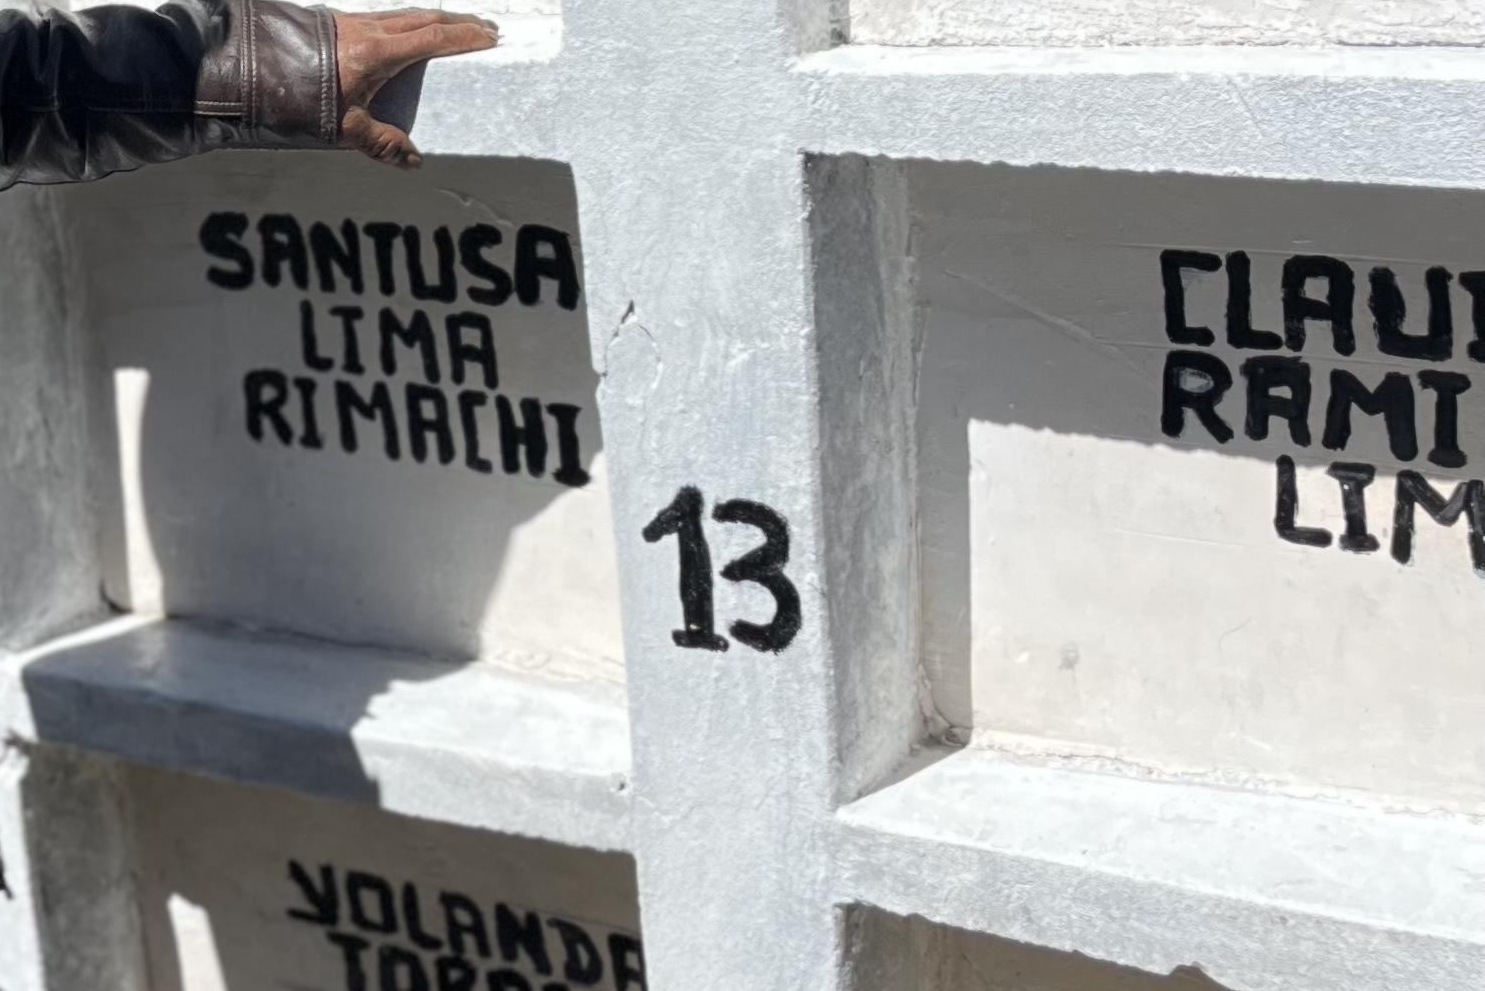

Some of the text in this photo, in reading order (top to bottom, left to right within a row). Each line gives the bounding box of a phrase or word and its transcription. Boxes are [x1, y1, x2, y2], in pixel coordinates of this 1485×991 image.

[199, 211, 582, 311] SANTUSA
[301, 300, 499, 389] LIMA
[243, 369, 591, 487] RIMACHI
[642, 484, 803, 655] 13
[1273, 454, 1485, 579] LIM
